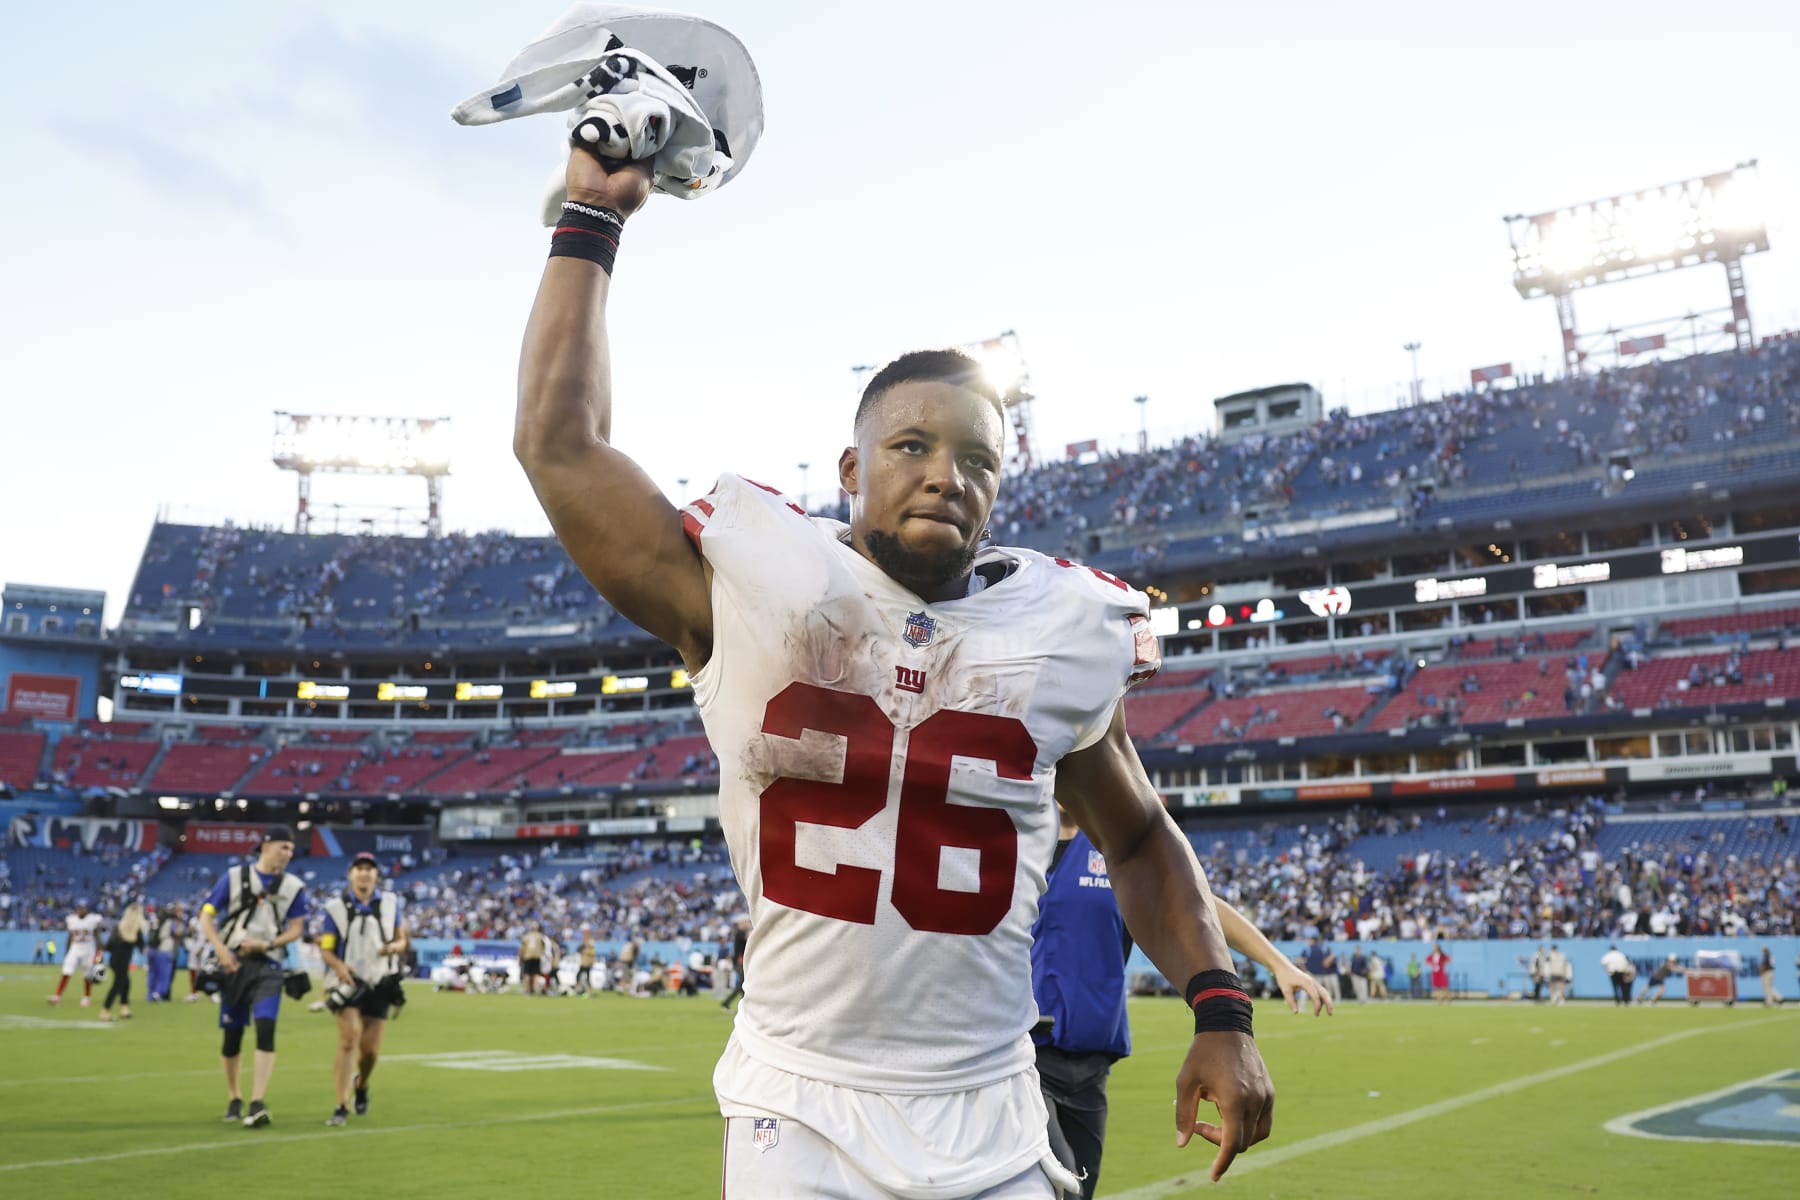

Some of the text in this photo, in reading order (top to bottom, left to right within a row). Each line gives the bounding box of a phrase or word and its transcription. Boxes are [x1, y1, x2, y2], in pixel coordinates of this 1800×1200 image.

[907, 624, 928, 641] NFL
[759, 681, 1038, 936] 26
[196, 829, 261, 842] NISSA
[756, 1130, 774, 1143] NFL
